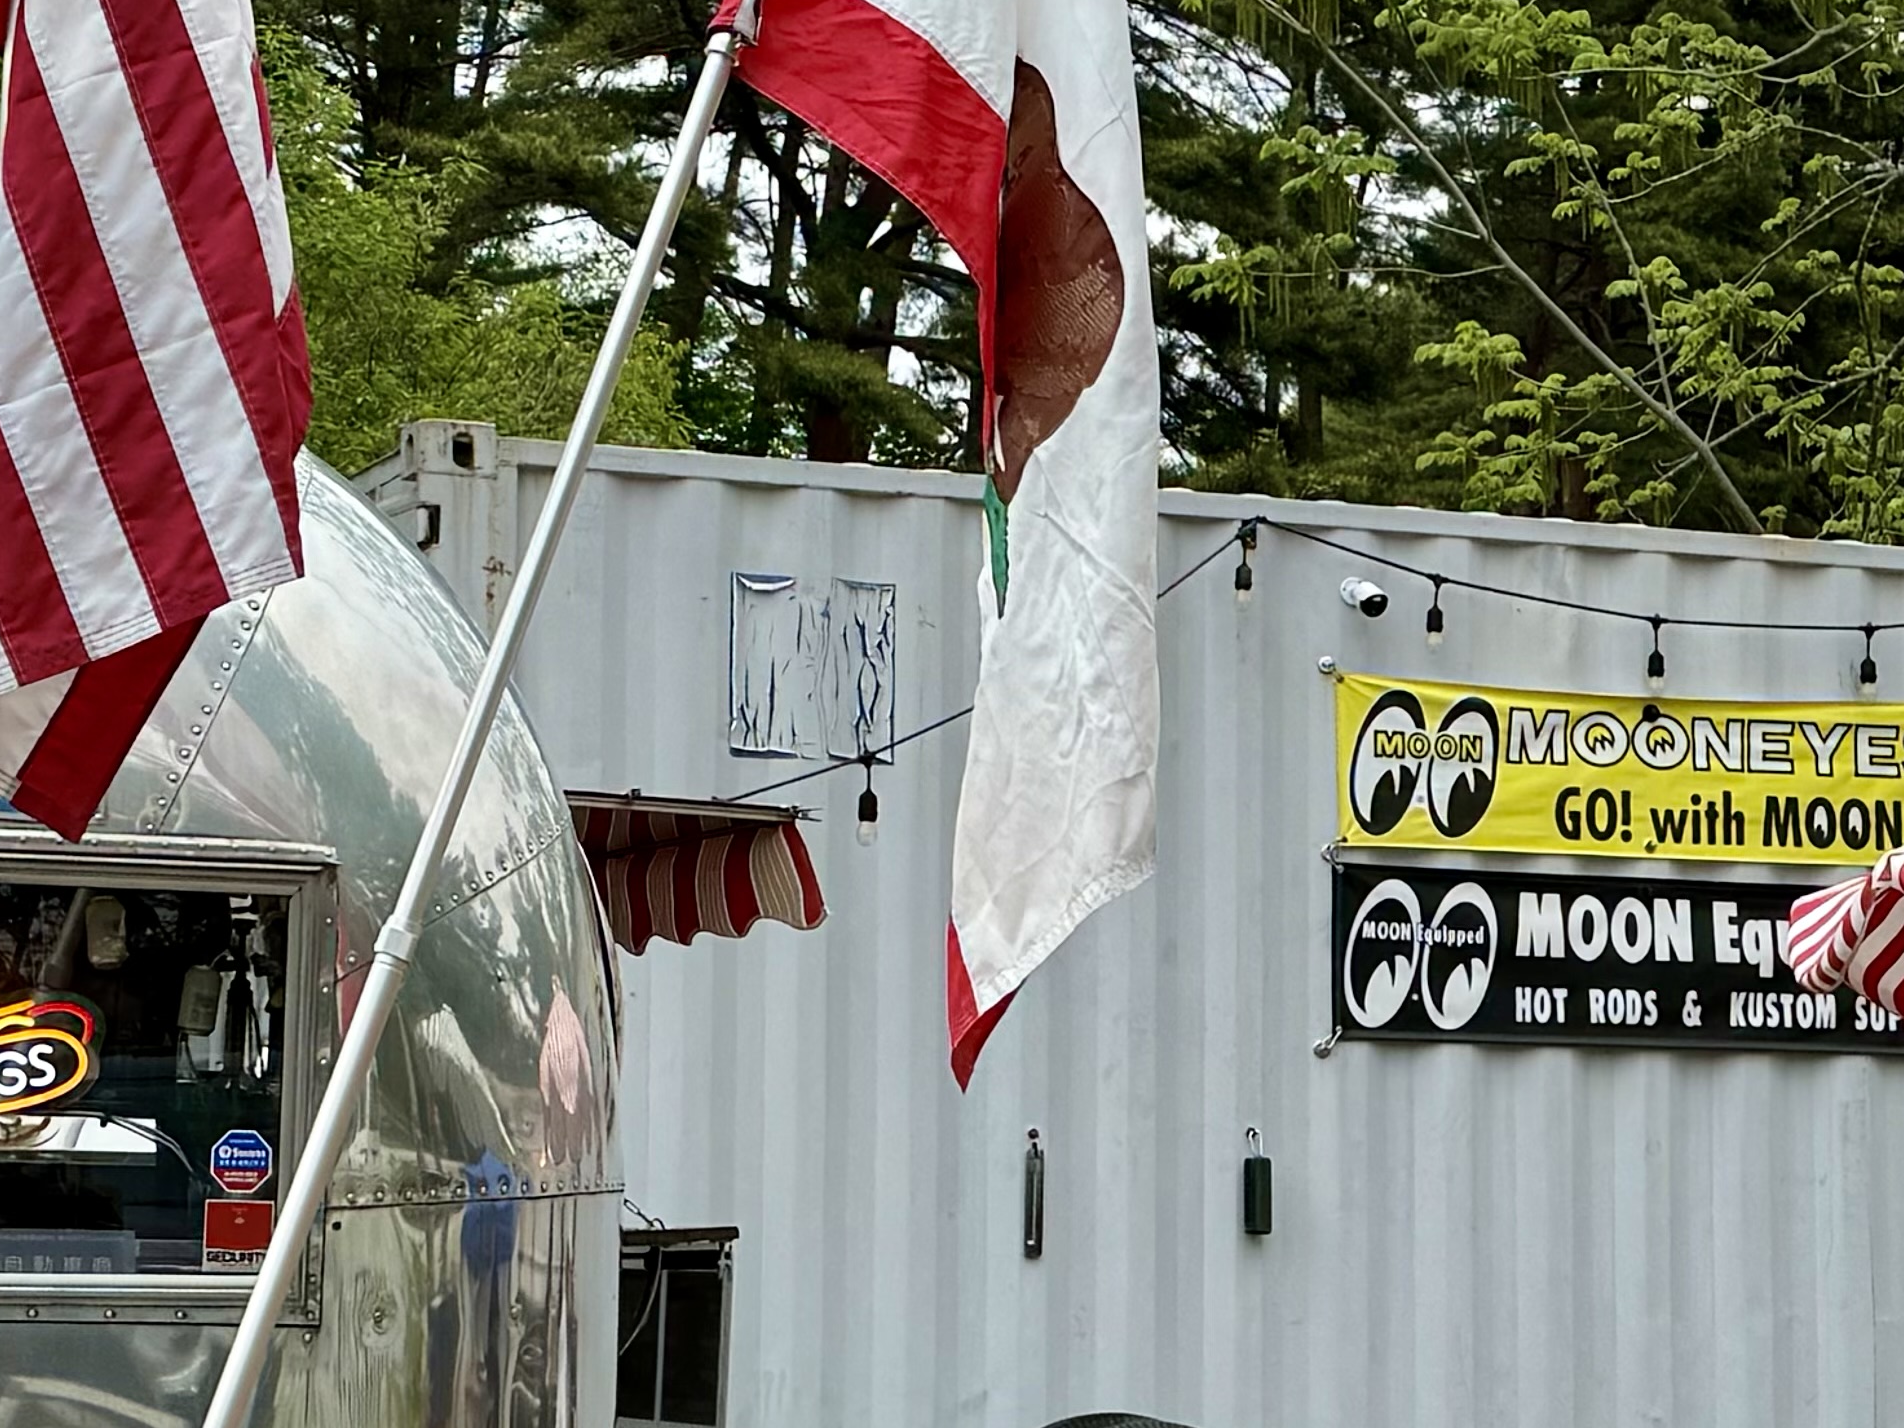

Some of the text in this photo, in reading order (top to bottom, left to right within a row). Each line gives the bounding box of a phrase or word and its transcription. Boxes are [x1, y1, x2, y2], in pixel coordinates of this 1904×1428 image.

[1373, 729, 1482, 763] MOON
[1555, 786, 1903, 851] GO! with MOON
[1361, 921, 1485, 947] MOON Equipped
[1515, 891, 1694, 964] MOON
[1515, 986, 1568, 1023] HOT
[1588, 988, 1658, 1026] RODS
[1682, 990, 1702, 1027] &
[1730, 991, 1836, 1029] KUSTOM
